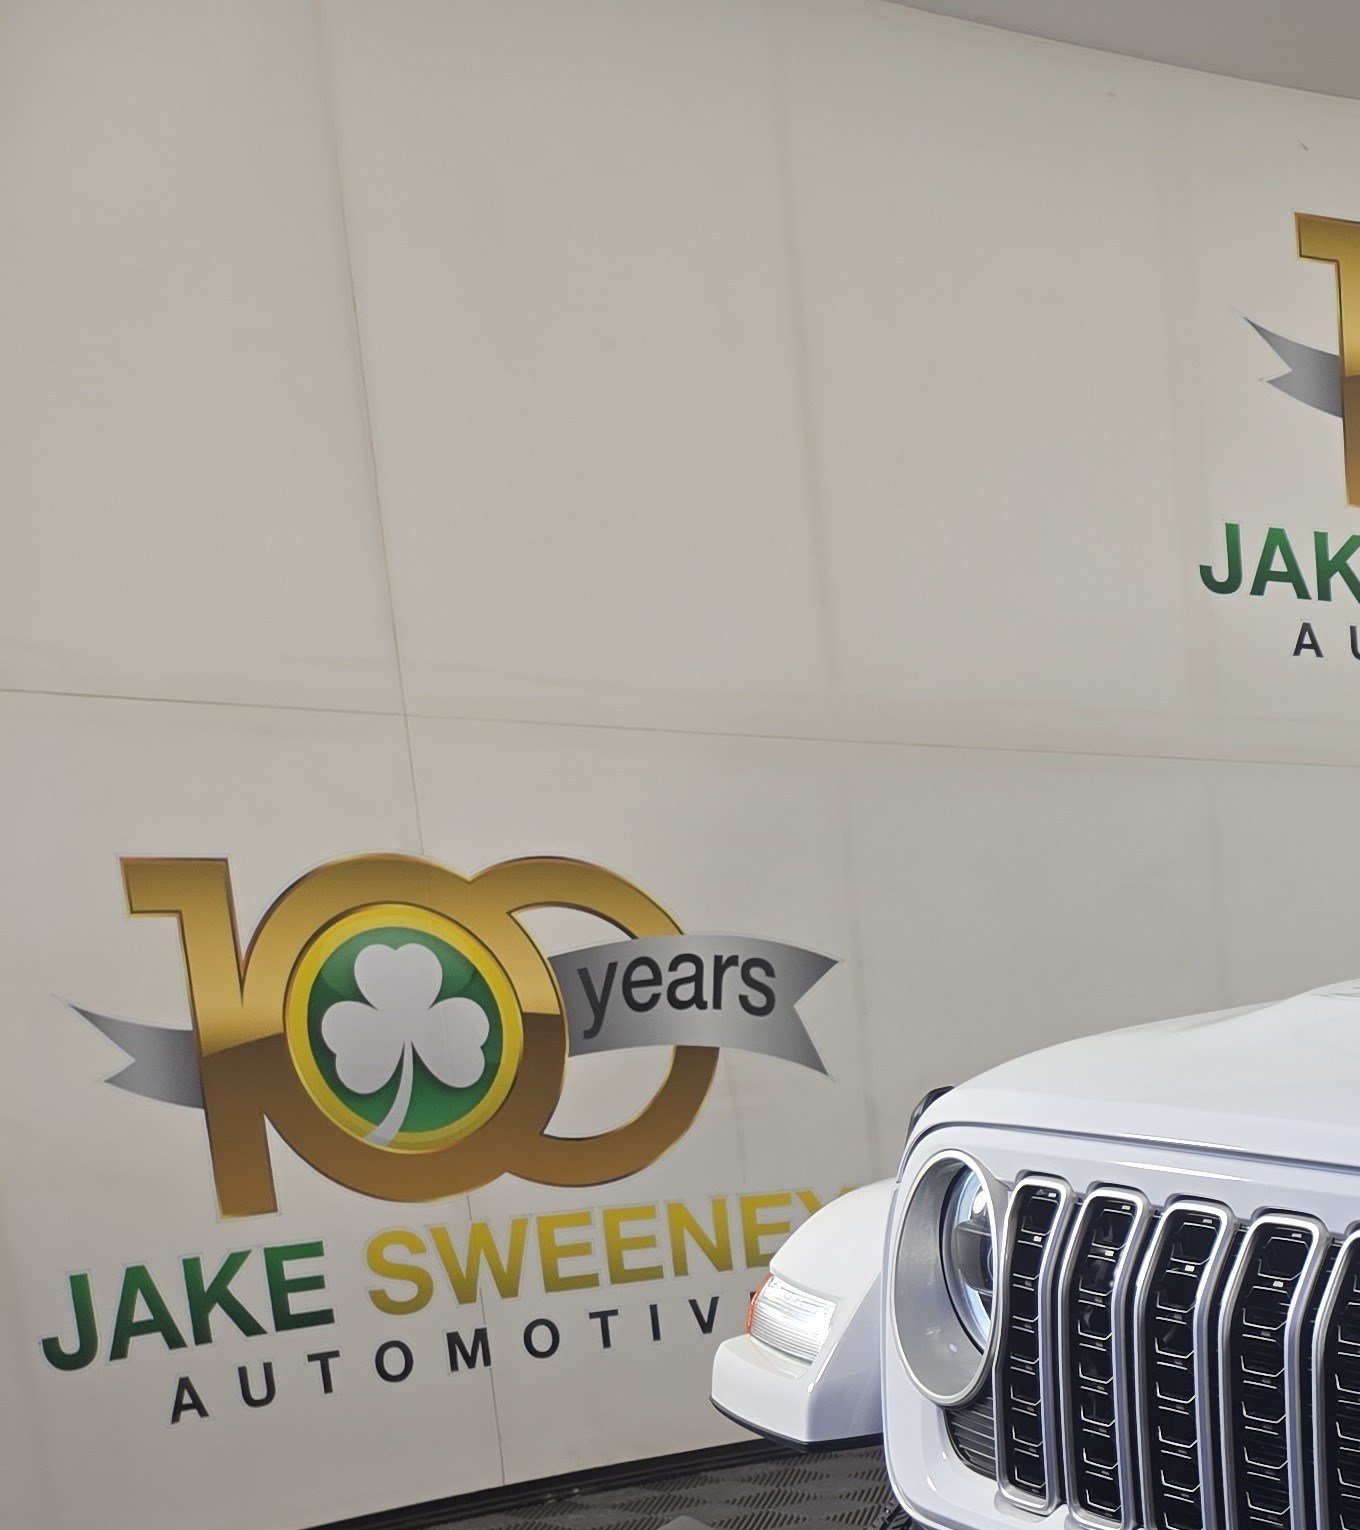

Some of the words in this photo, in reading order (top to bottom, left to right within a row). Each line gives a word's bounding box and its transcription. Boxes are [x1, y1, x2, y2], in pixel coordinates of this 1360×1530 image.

[119, 853, 720, 1220] 100
[577, 952, 777, 1039] years
[42, 1240, 335, 1371] JAKE
[169, 1292, 757, 1425] AUTOMOTIV
